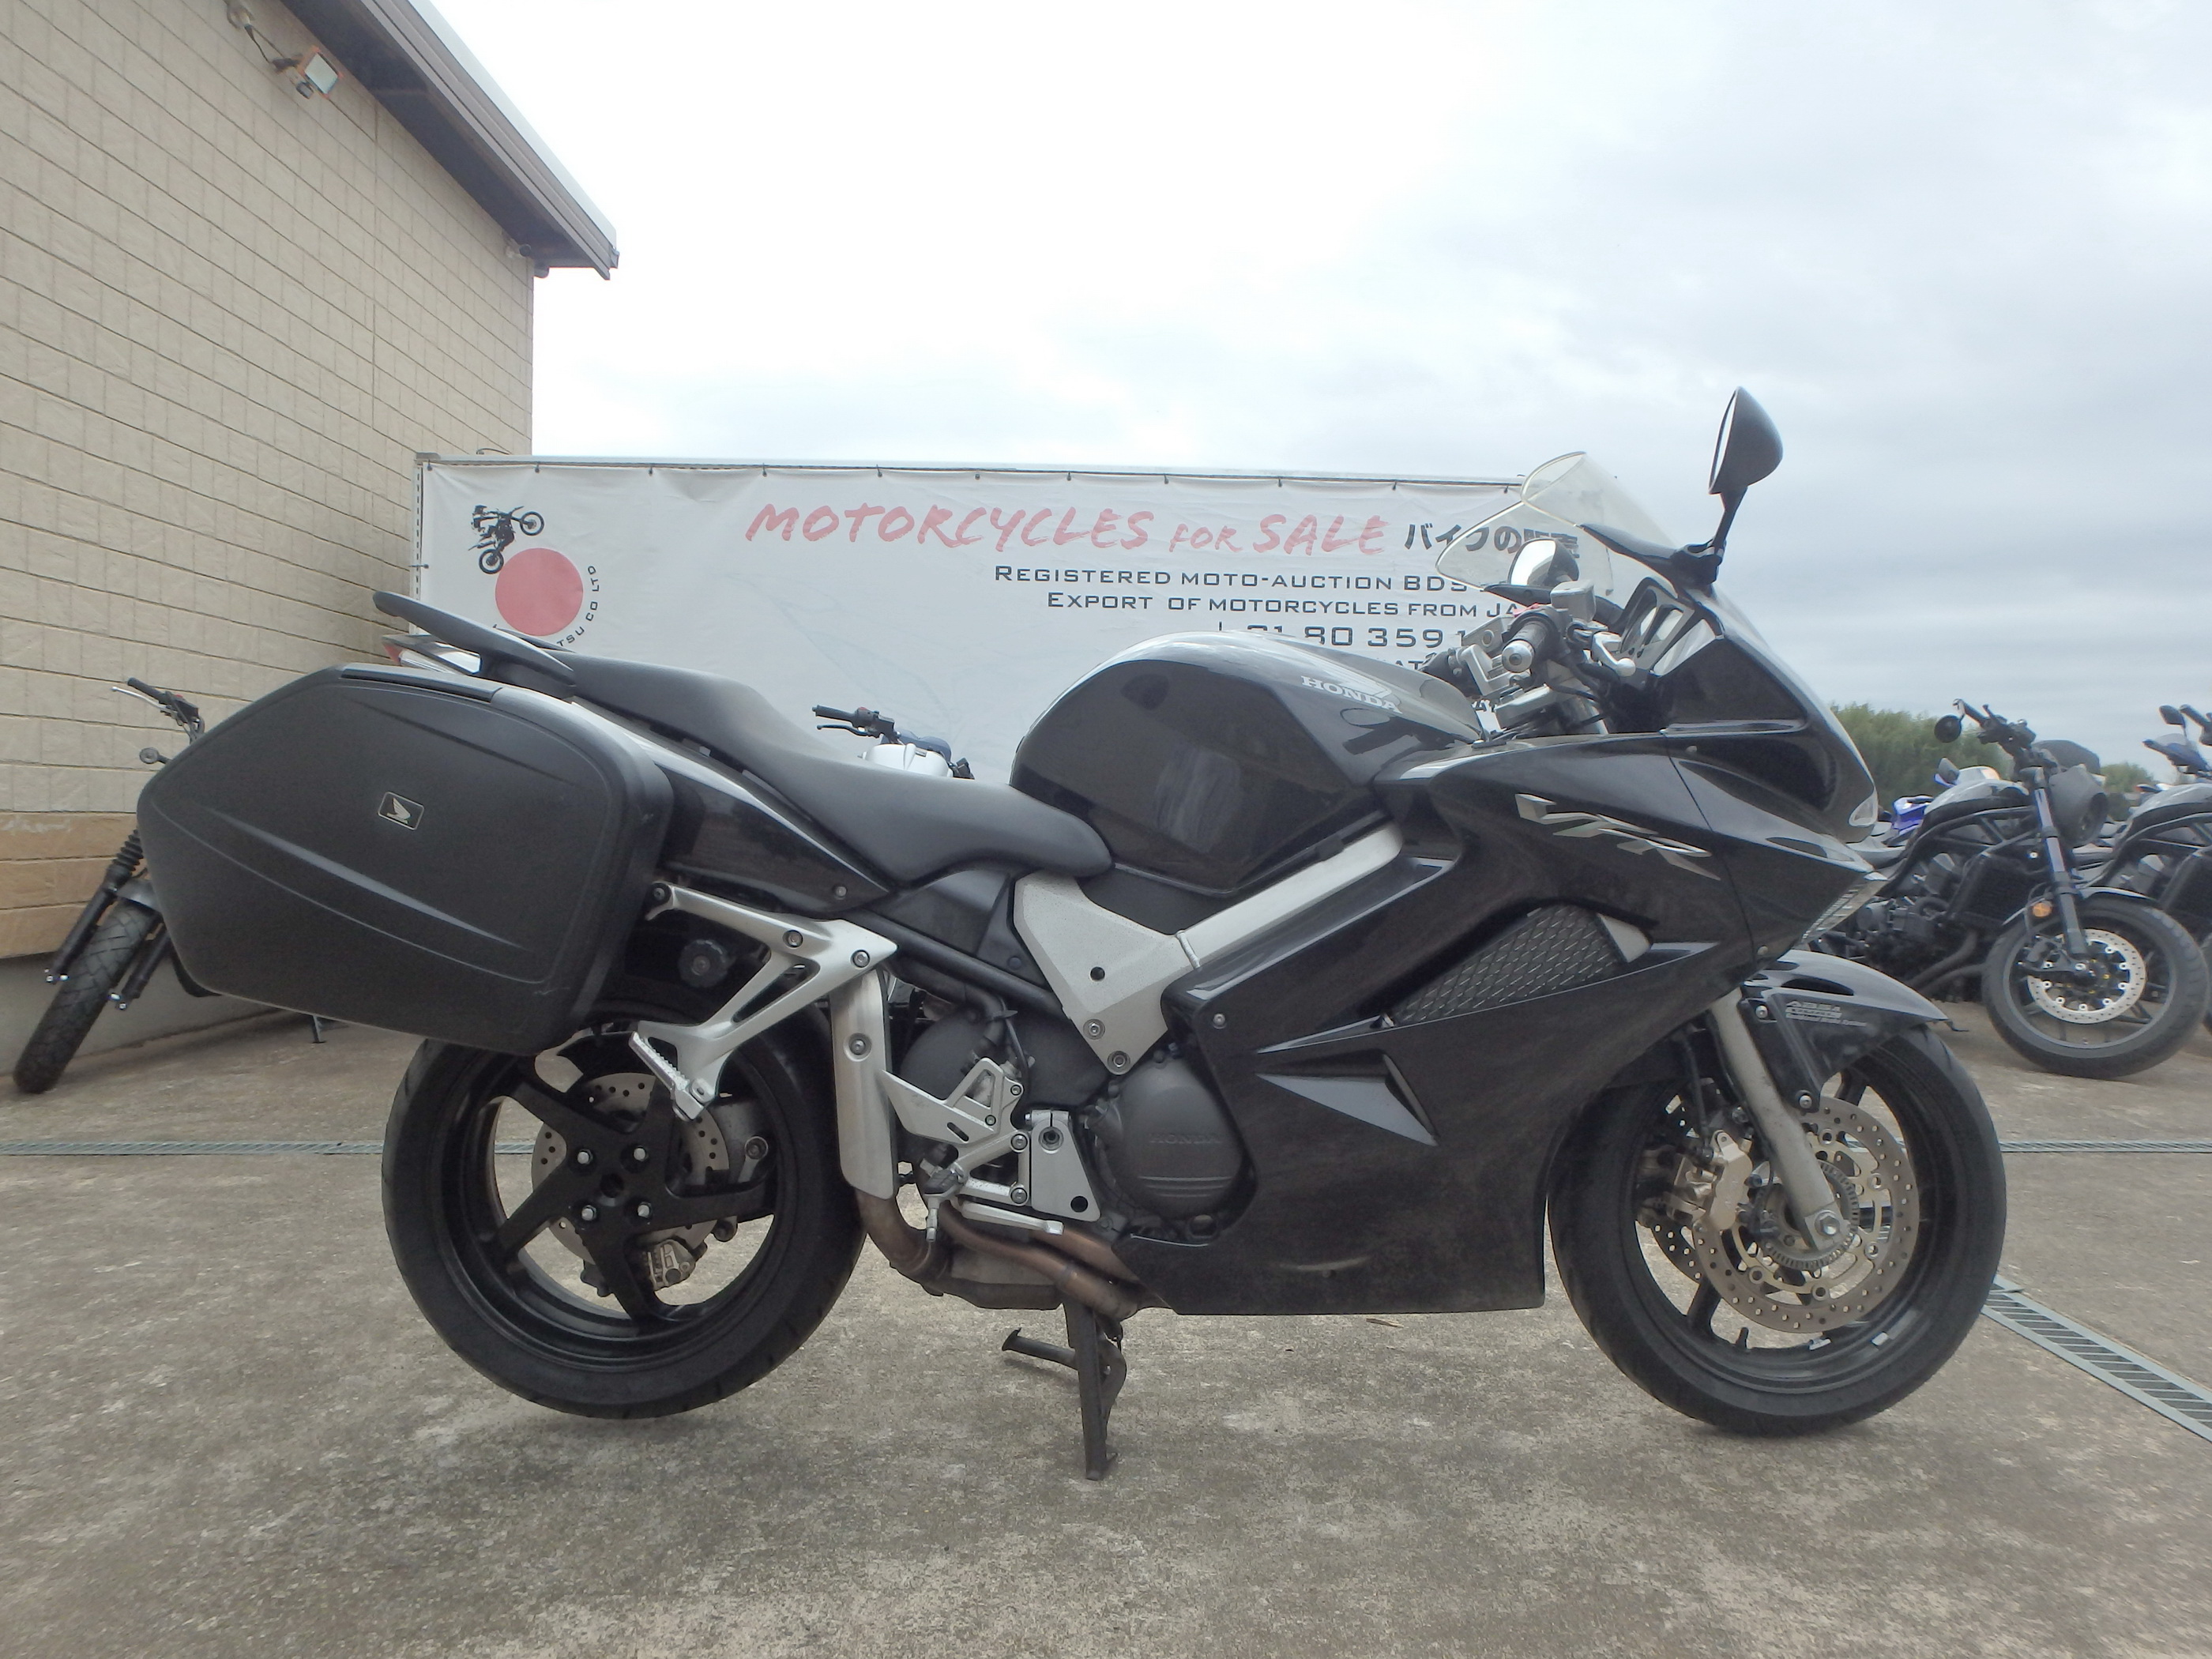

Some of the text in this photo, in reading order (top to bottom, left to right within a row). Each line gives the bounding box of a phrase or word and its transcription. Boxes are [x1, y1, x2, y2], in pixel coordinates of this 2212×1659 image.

[744, 502, 1391, 555] MOTORCYCLES FOR SALE
[587, 565, 600, 592] LTD
[995, 565, 1171, 585] REGISTERED
[1180, 573, 1392, 590] MOTO-AUCTION
[585, 600, 599, 622] CO
[1048, 592, 1153, 609] EXPORT
[1168, 597, 1202, 611] OF
[1209, 598, 1399, 616] MOTORCYCLES
[1408, 603, 1477, 617] FROM
[1367, 627, 1444, 649] 359
[1300, 675, 1403, 714] HONDA
